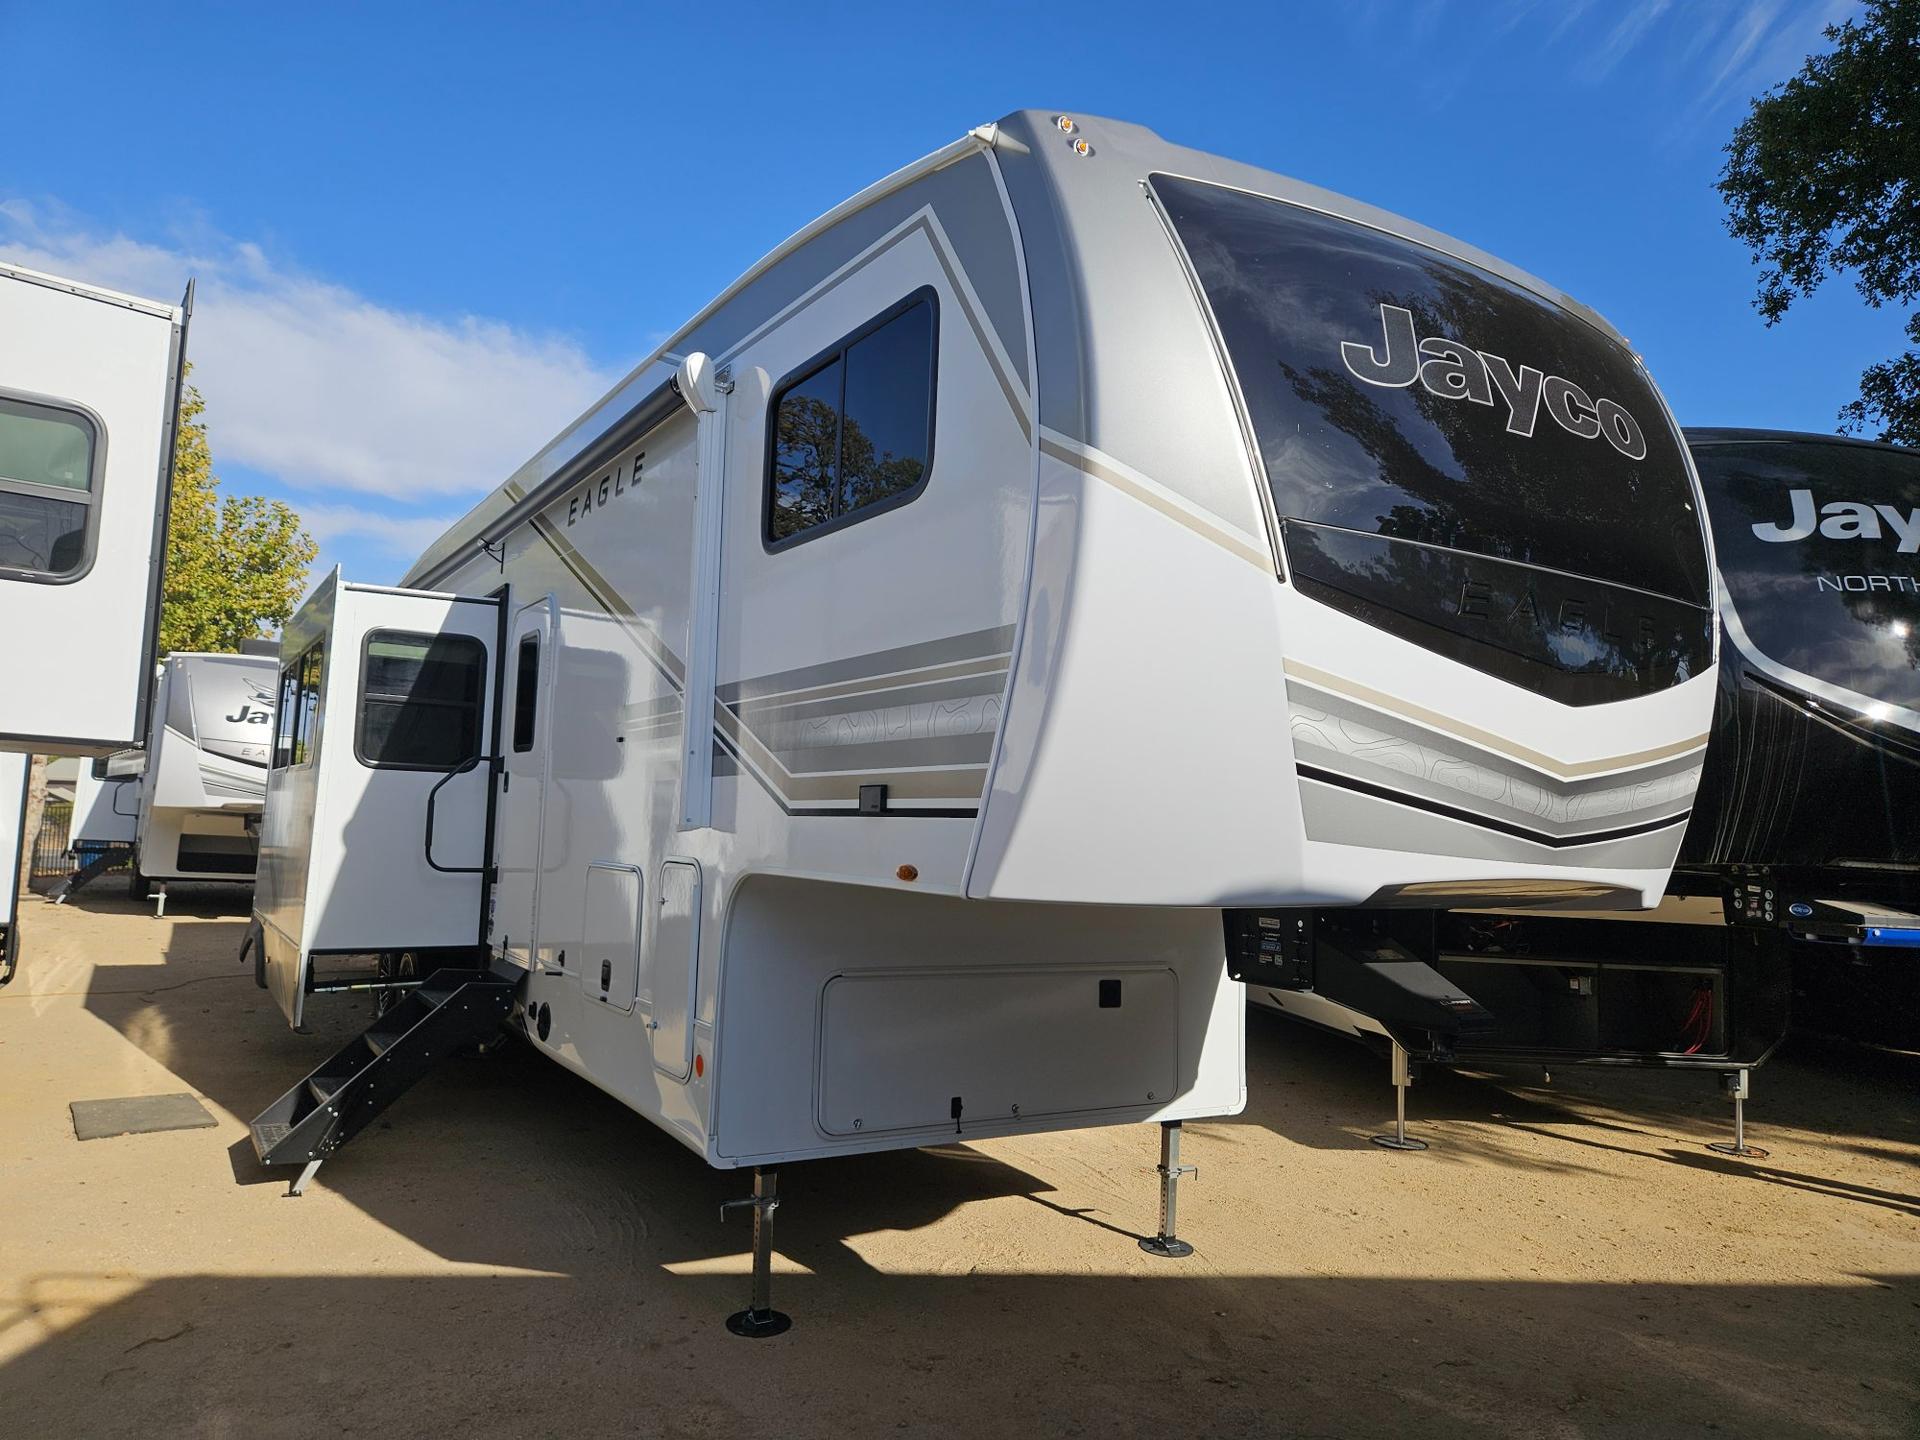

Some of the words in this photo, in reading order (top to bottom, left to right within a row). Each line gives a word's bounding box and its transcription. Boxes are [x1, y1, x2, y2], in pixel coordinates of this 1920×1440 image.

[1341, 303, 1647, 460] Jayco
[565, 451, 646, 527] EAGLE
[1751, 489, 1920, 553] Jay
[1457, 577, 1656, 648] EAGLE
[225, 705, 274, 730] Ja
